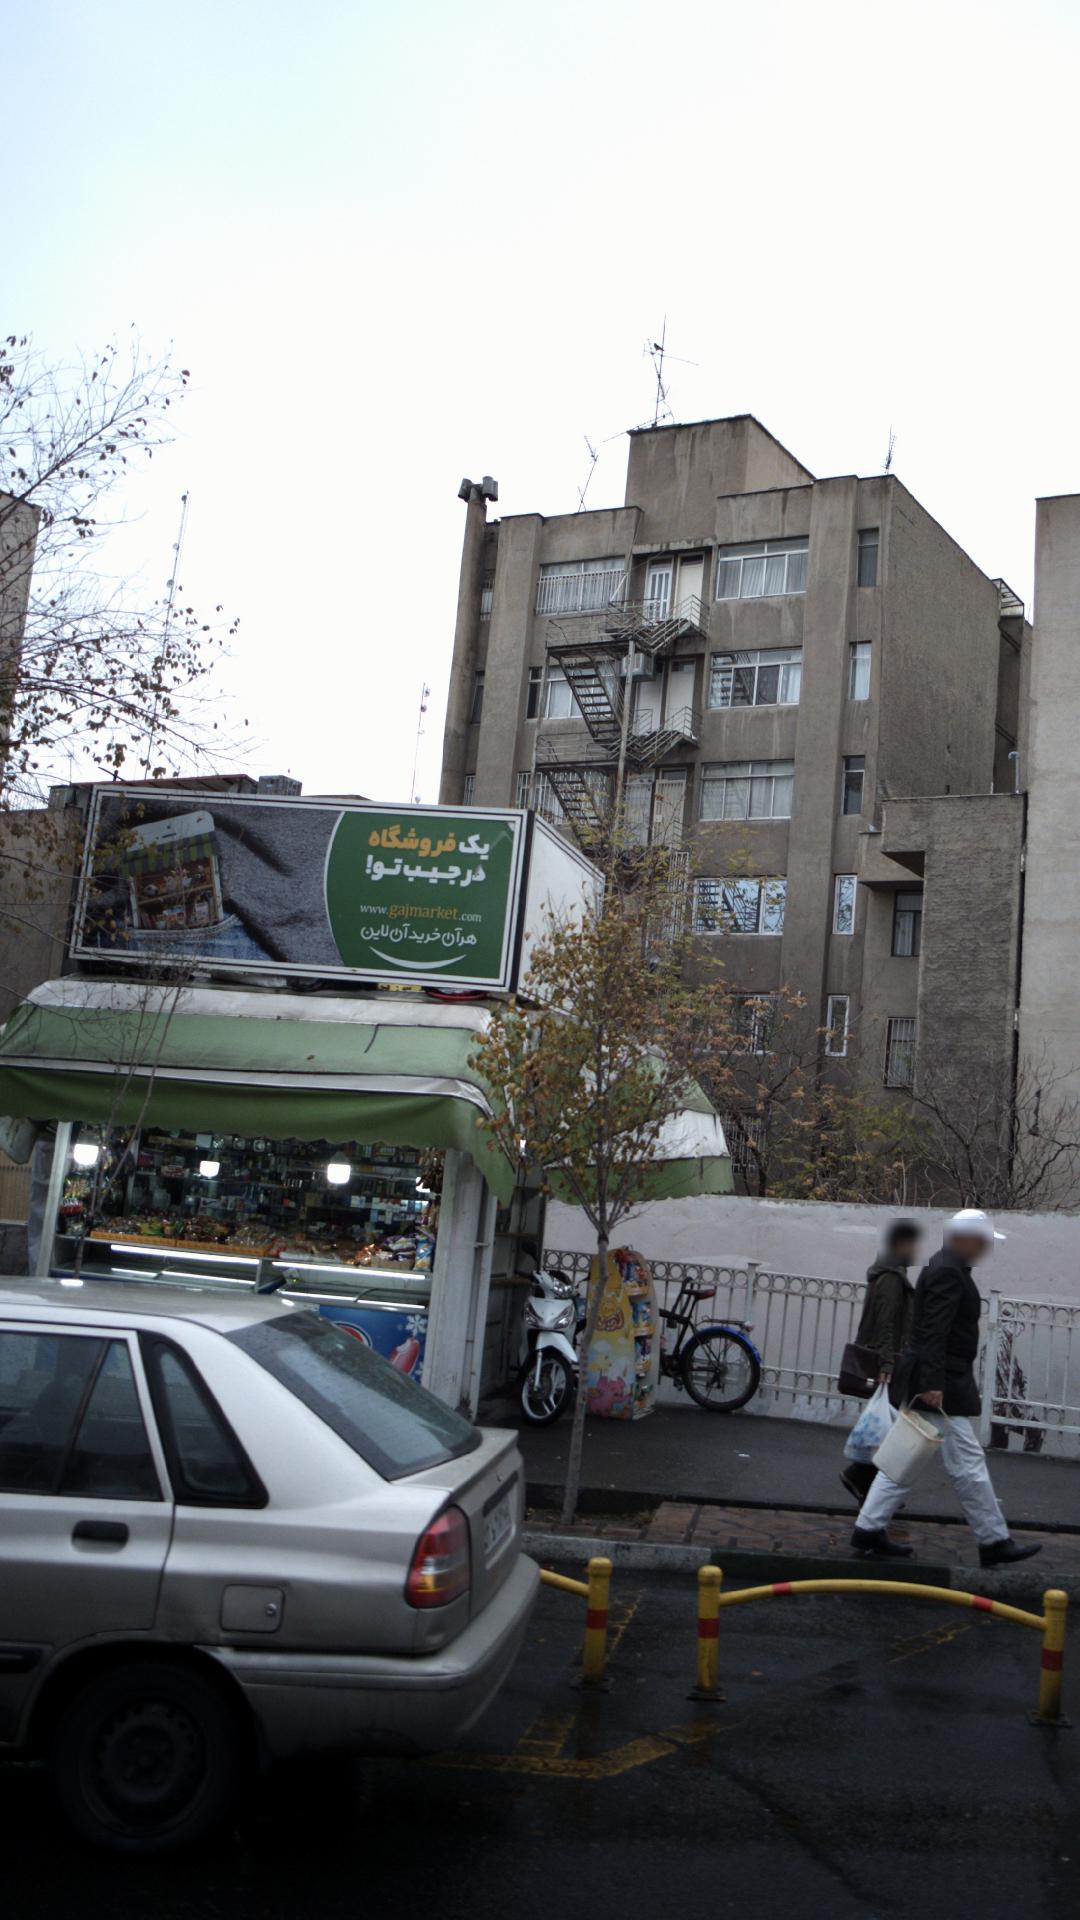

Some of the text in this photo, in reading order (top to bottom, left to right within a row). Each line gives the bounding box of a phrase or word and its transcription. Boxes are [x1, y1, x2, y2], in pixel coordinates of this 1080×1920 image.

[368, 824, 490, 861] یک فروشگاه
[403, 864, 462, 885] جیب
[360, 904, 482, 923] www.gajmarket.com
[408, 928, 441, 944] خرید
